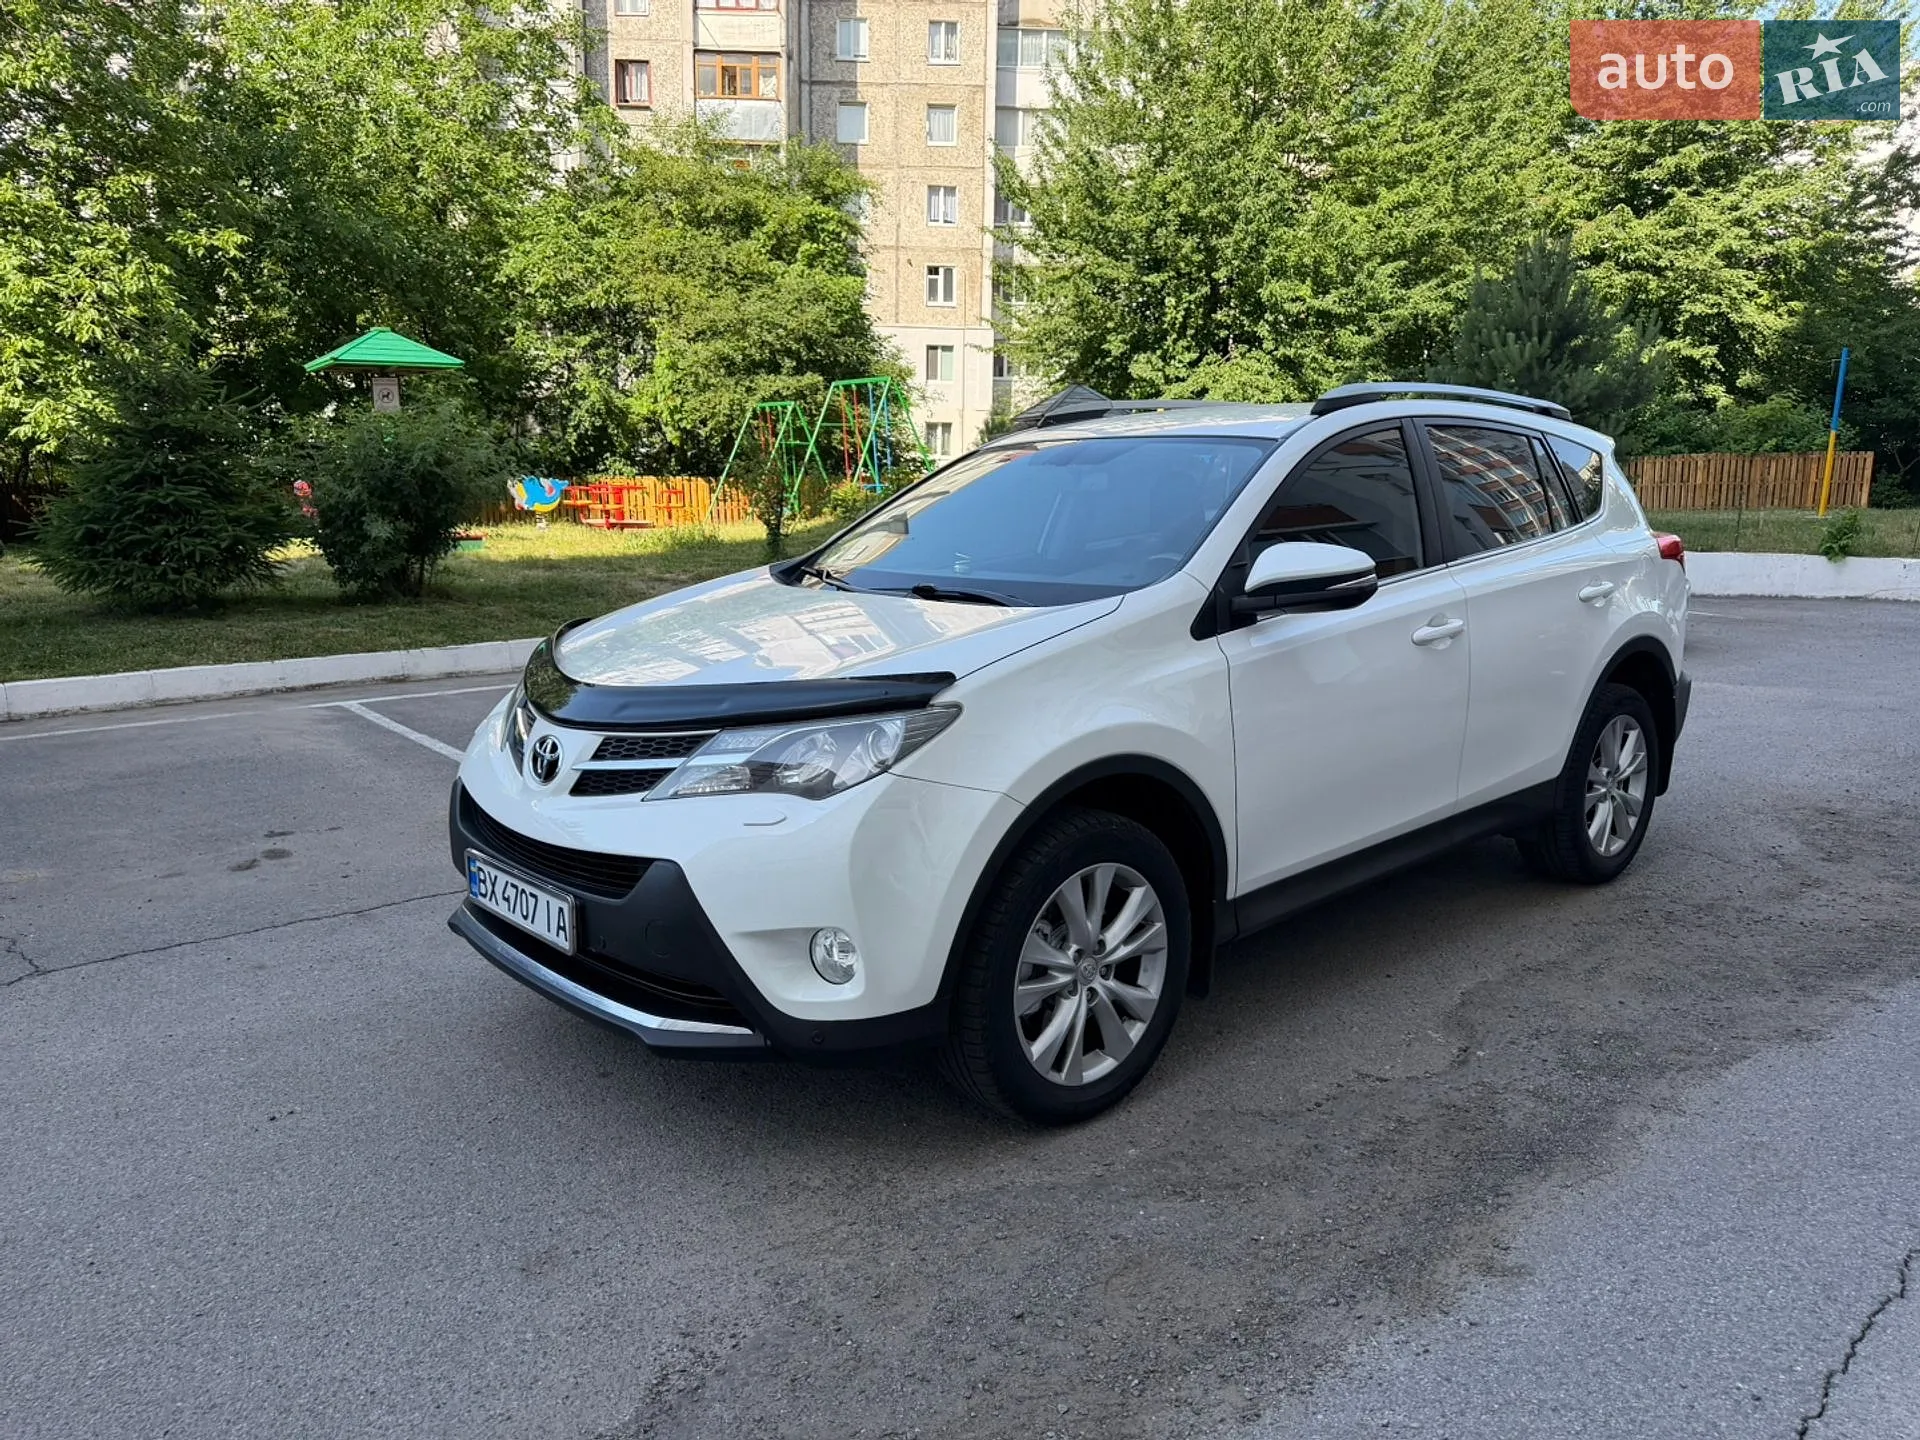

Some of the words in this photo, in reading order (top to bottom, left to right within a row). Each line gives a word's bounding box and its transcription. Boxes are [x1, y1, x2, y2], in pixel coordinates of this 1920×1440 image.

[477, 866, 499, 907] BX
[502, 880, 539, 925] 4707
[546, 899, 568, 942] IA
